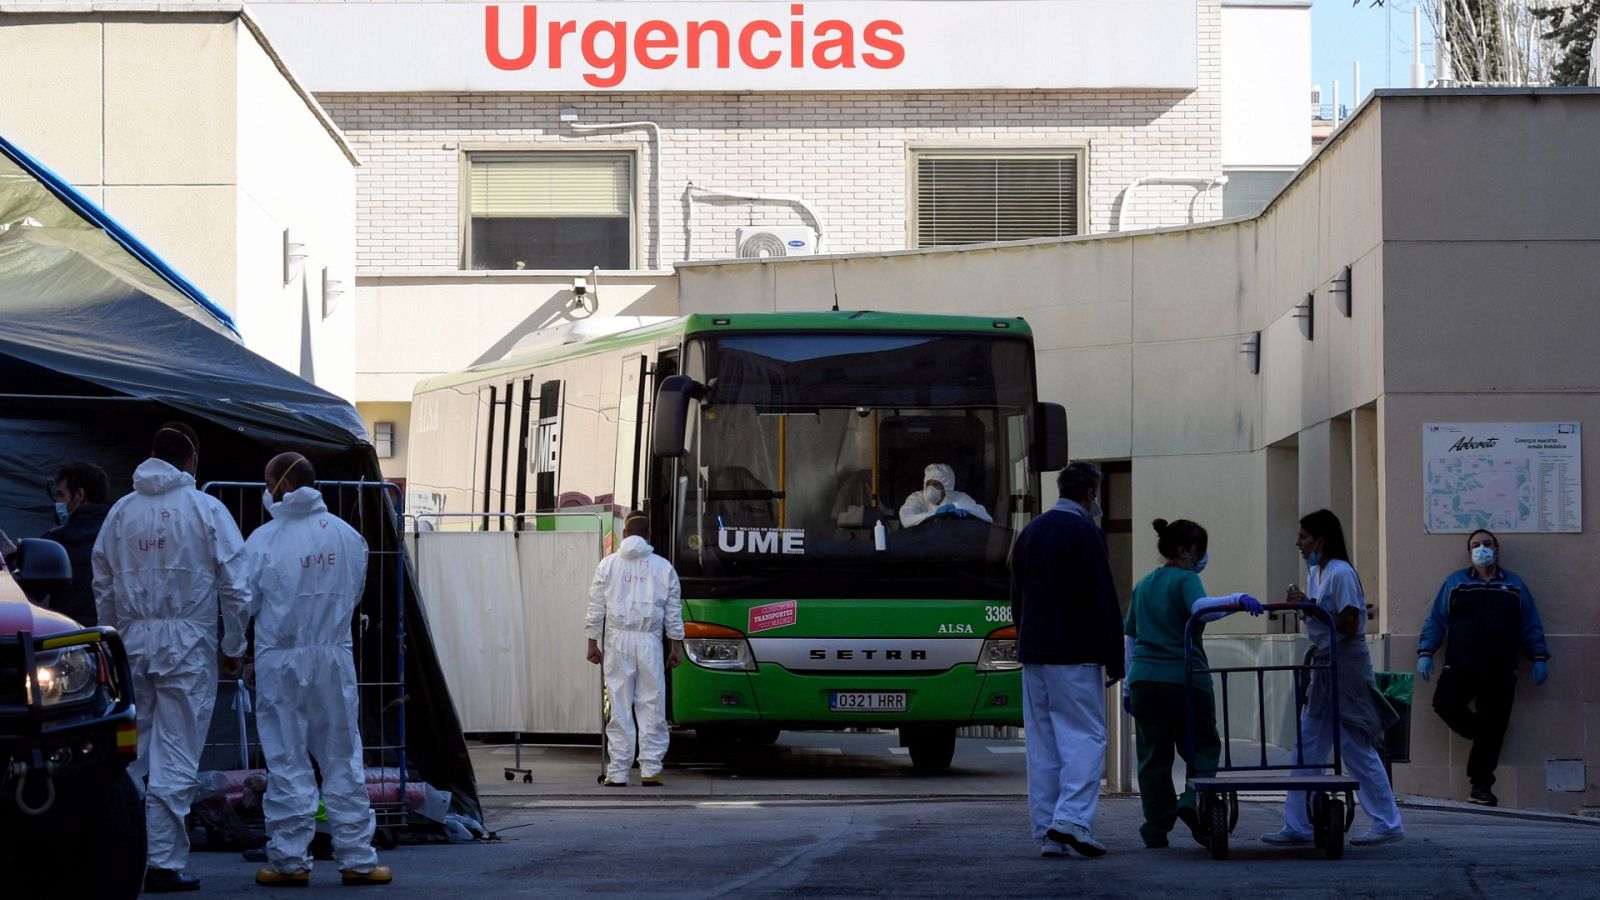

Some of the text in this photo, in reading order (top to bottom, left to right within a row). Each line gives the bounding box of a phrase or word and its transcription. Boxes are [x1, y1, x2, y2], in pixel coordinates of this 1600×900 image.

[485, 3, 906, 88] Urgencias
[529, 424, 557, 475] UME
[1448, 436, 1499, 452] Arboreto
[161, 511, 171, 522] P
[718, 530, 805, 554] UME
[300, 553, 335, 571] UME
[754, 610, 792, 622] TRANSPORTES
[938, 624, 973, 633] ALSA
[810, 650, 926, 660] SETRA
[839, 695, 903, 707] 0321 HRR
